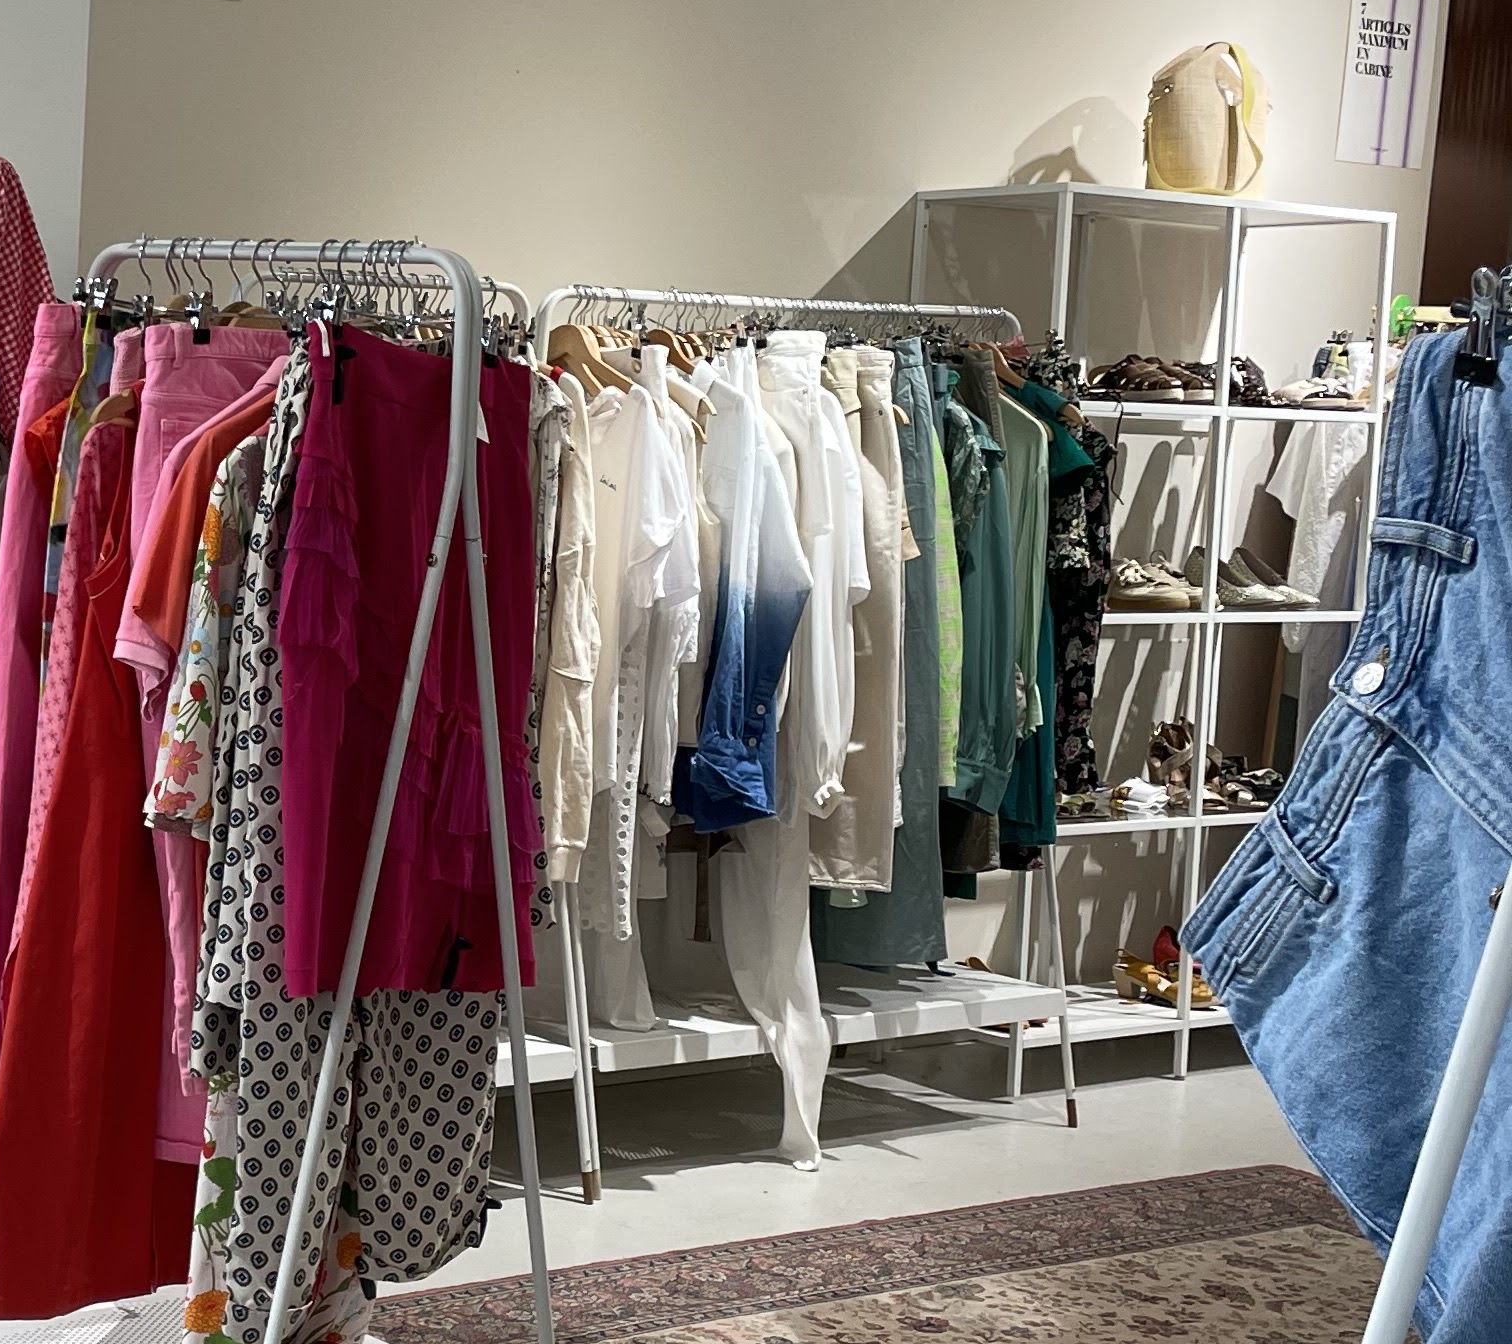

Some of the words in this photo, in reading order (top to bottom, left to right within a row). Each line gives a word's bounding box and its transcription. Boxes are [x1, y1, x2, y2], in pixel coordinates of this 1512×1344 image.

[1361, 2, 1367, 14] 7
[1359, 17, 1412, 37] ARTICLES
[1357, 32, 1409, 51] MAXIMUM
[1356, 47, 1370, 60] EN
[1355, 61, 1393, 78] CABINE
